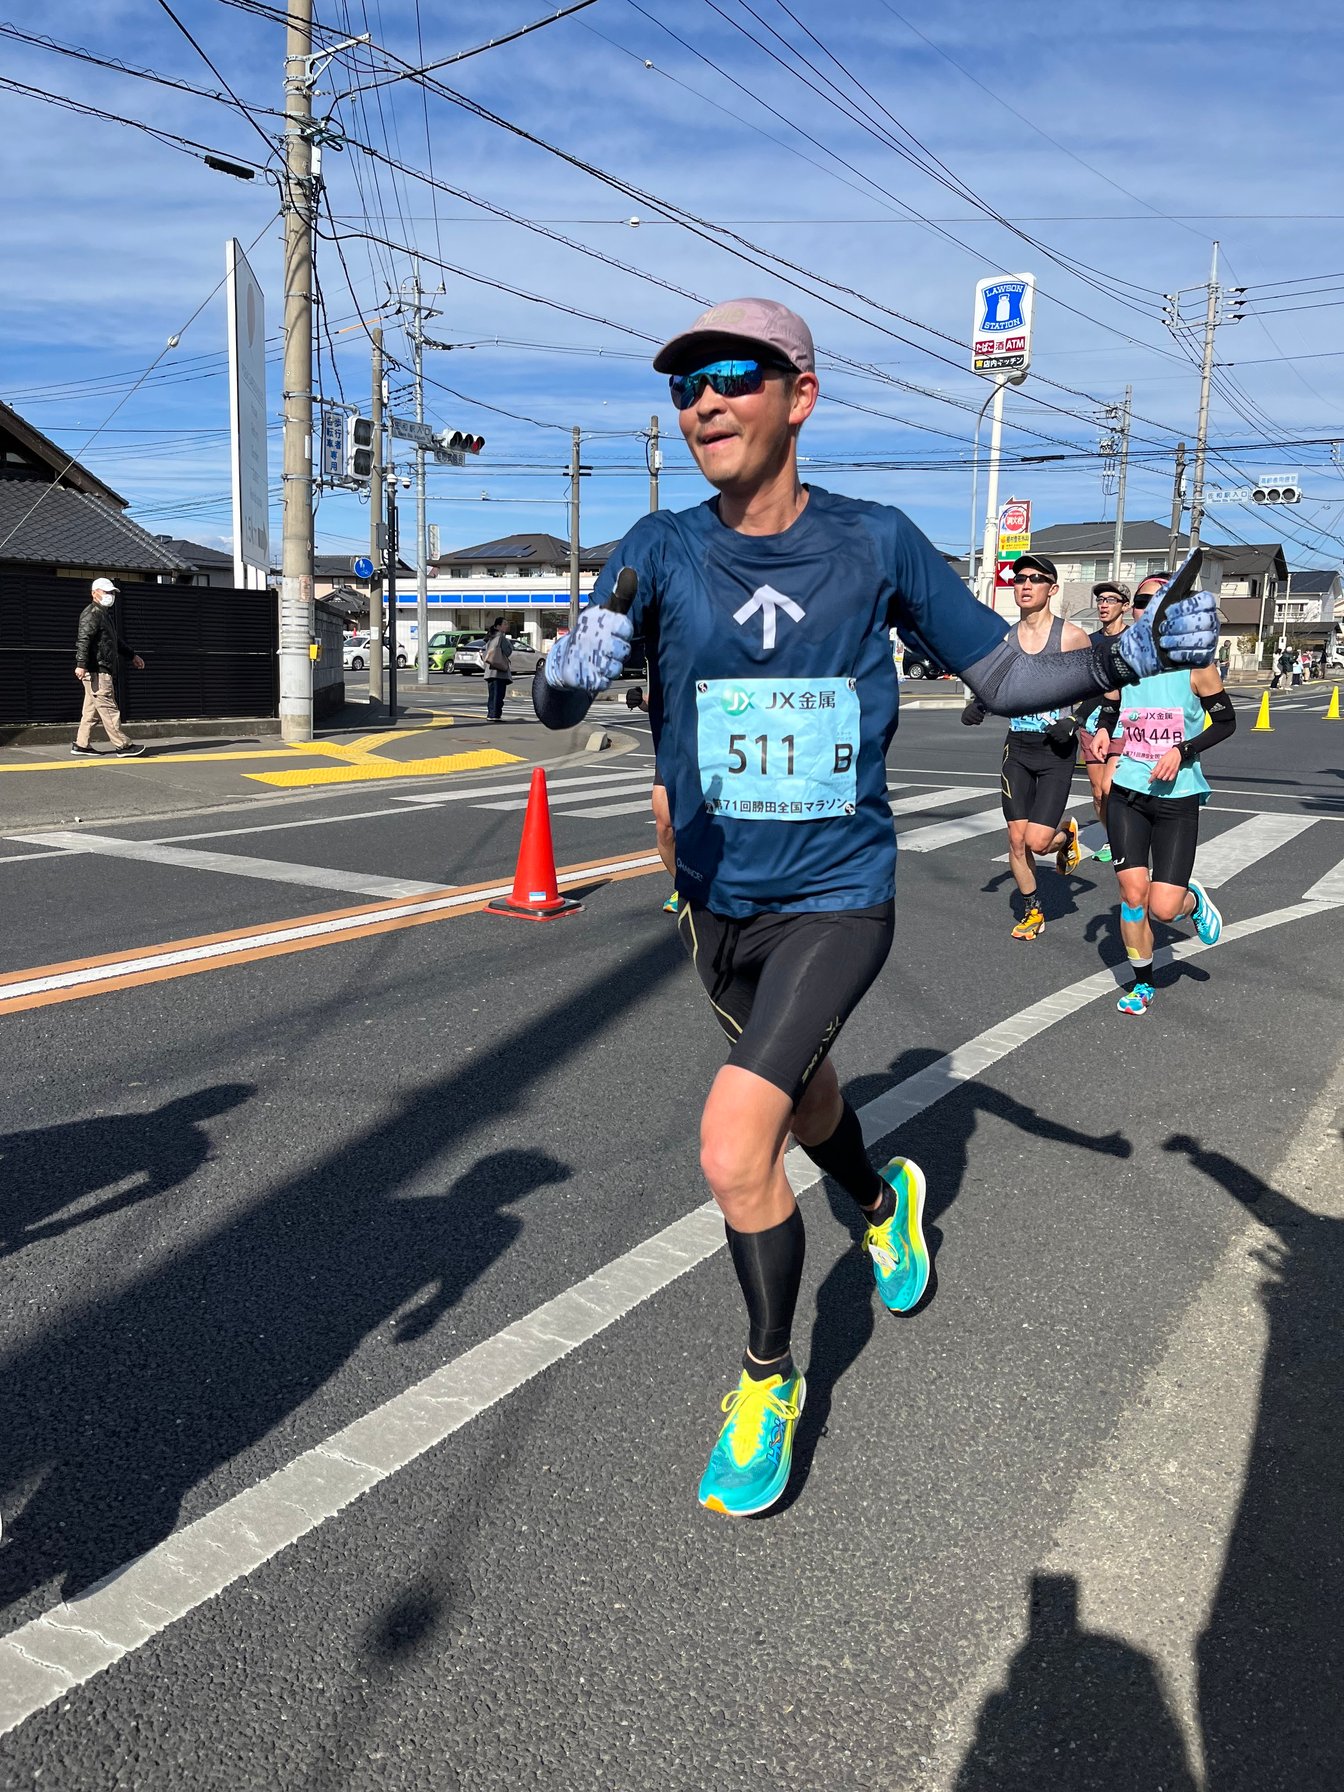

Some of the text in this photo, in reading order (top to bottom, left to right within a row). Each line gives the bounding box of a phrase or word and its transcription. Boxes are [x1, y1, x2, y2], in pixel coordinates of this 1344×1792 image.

[985, 284, 1024, 298] LAWSON
[983, 317, 1021, 330] STATION
[976, 342, 994, 353] たばこ
[1006, 338, 1025, 350] ATM
[983, 356, 1024, 368] 店内キッチン
[330, 450, 338, 471] 専用
[727, 691, 756, 711] JX
[765, 690, 836, 710] JX金属
[1144, 712, 1173, 720] JX金属
[1173, 731, 1183, 743] B
[728, 734, 853, 775] 511 B
